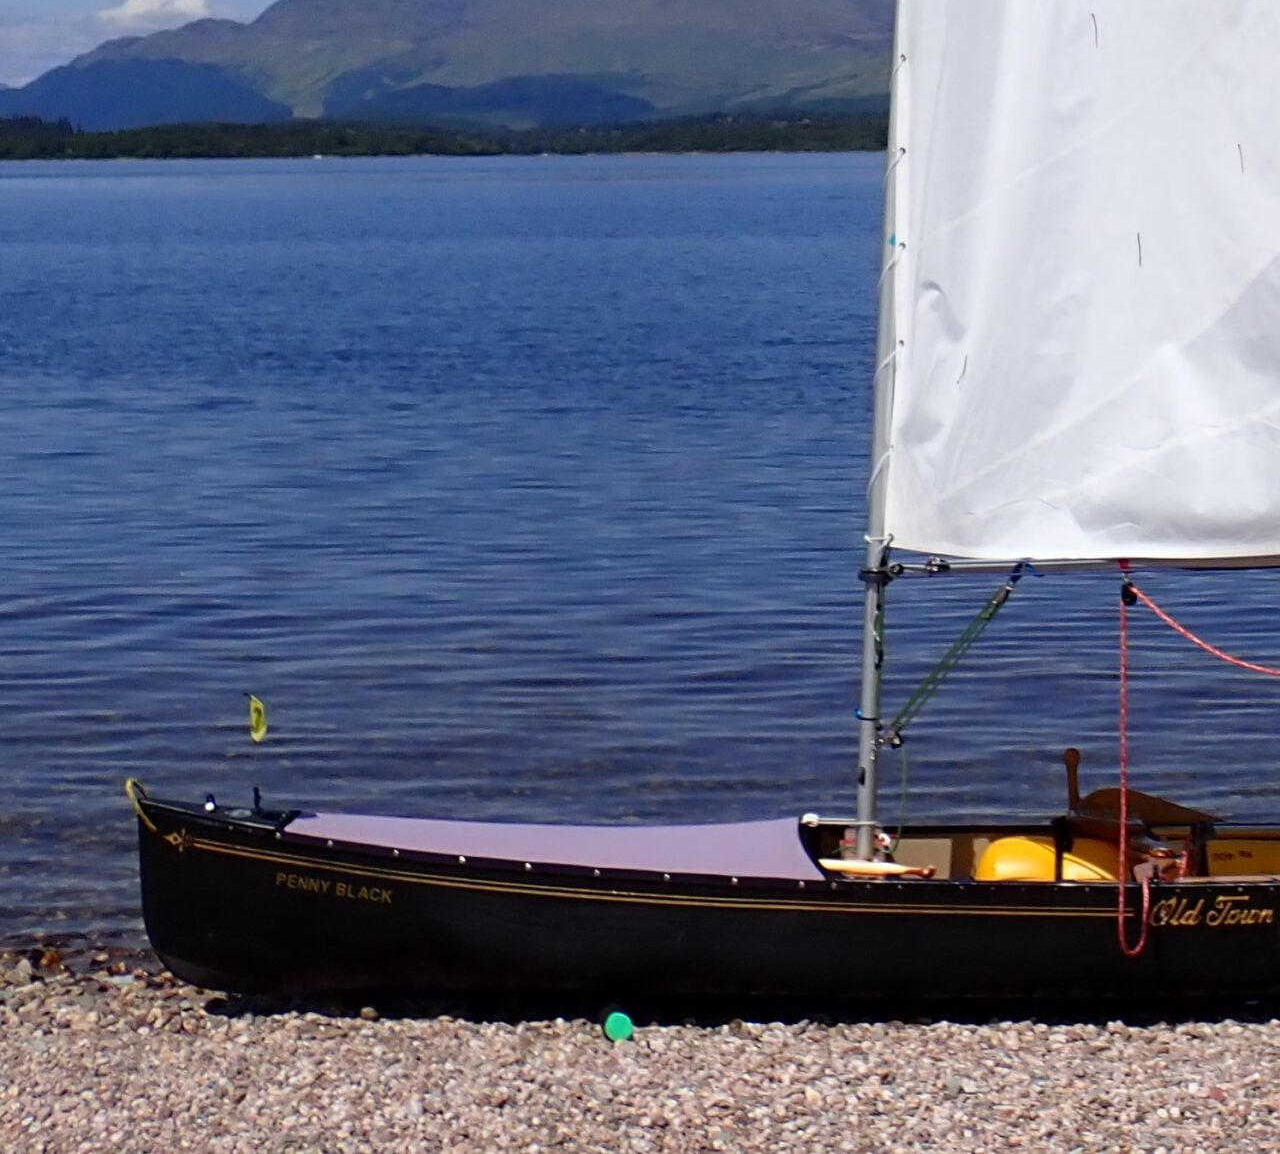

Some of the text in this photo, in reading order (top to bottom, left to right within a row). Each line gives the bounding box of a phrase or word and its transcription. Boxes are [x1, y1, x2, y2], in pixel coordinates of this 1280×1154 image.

[276, 872, 392, 903] PENNY BLACK
[1150, 896, 1273, 926] Old Town
